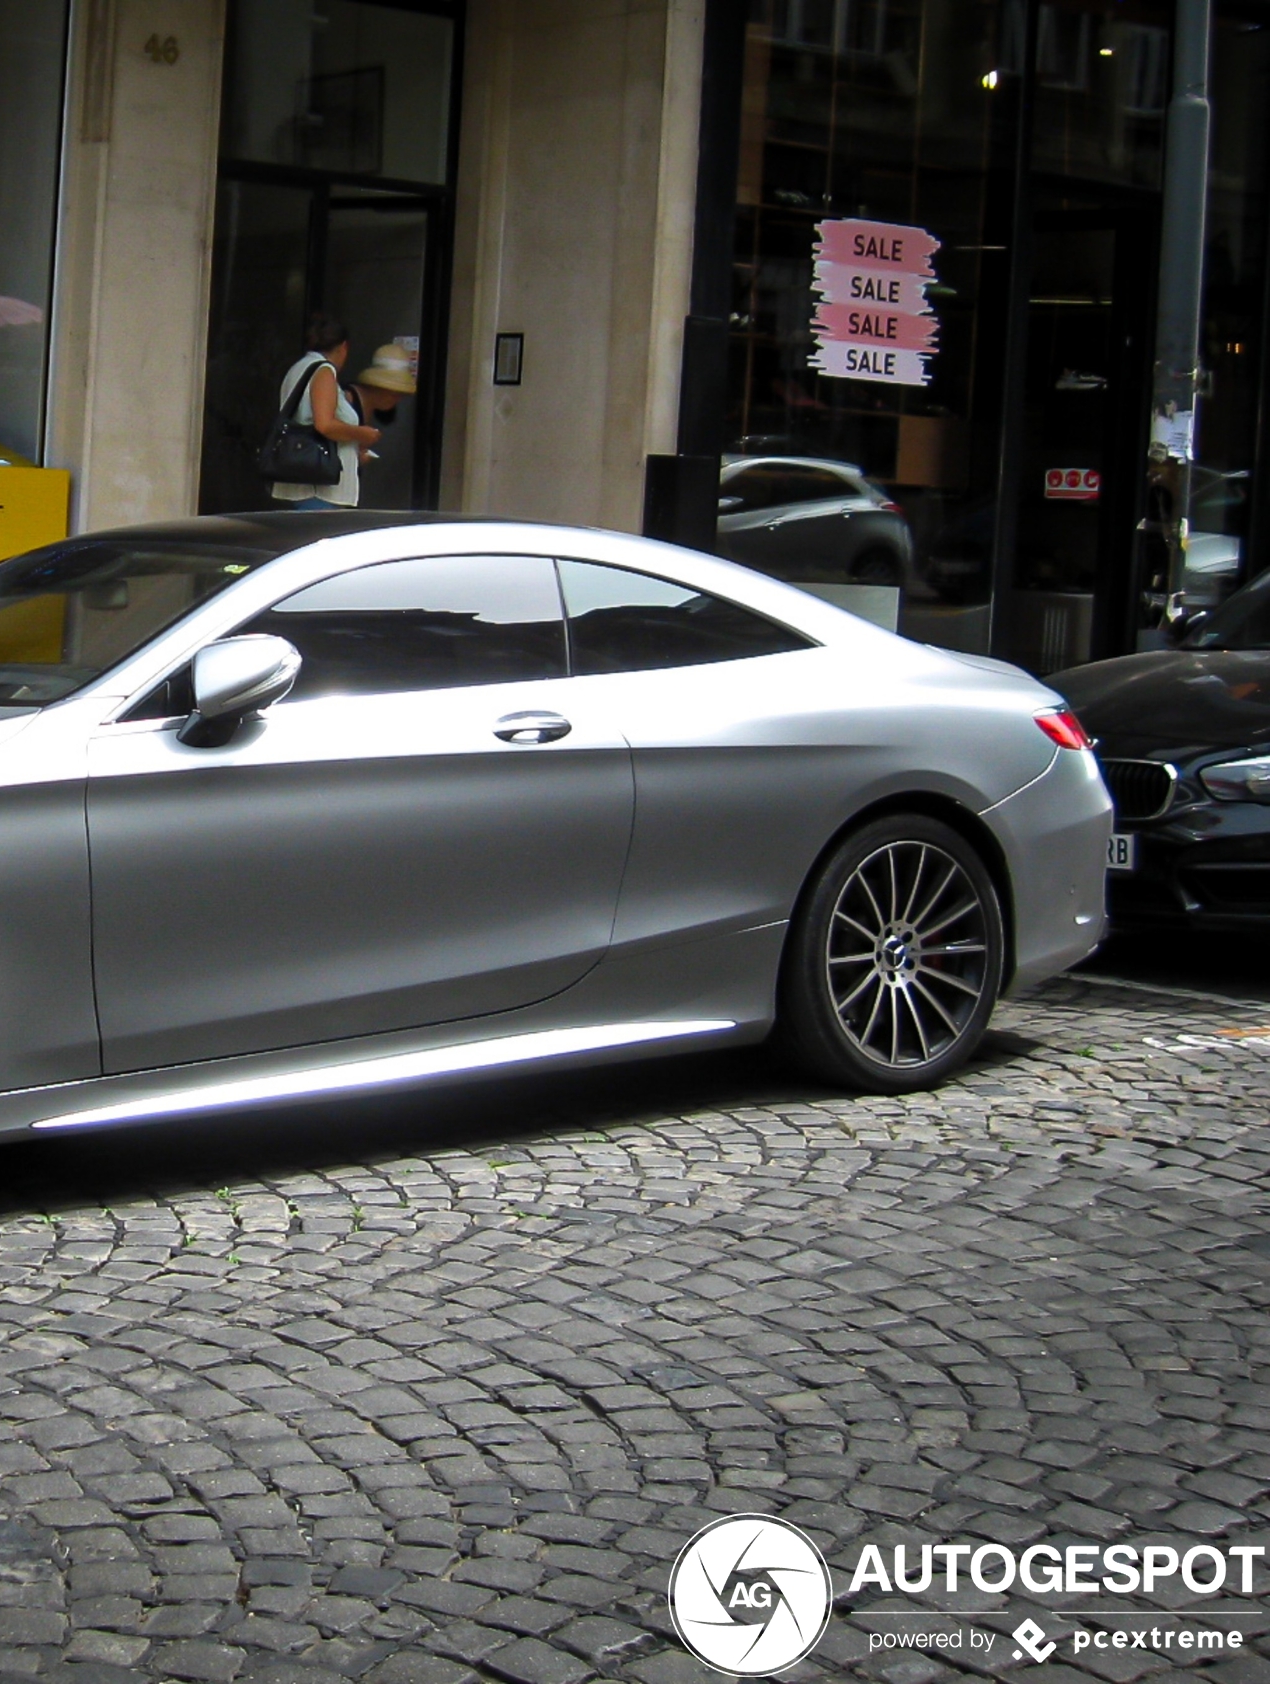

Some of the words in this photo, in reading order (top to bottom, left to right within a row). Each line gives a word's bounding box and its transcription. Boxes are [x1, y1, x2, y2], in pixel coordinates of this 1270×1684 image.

[144, 32, 179, 65] 46
[853, 234, 903, 262] SALE
[850, 276, 900, 303] SALE
[848, 313, 898, 340] SALE
[845, 349, 896, 376] SALE
